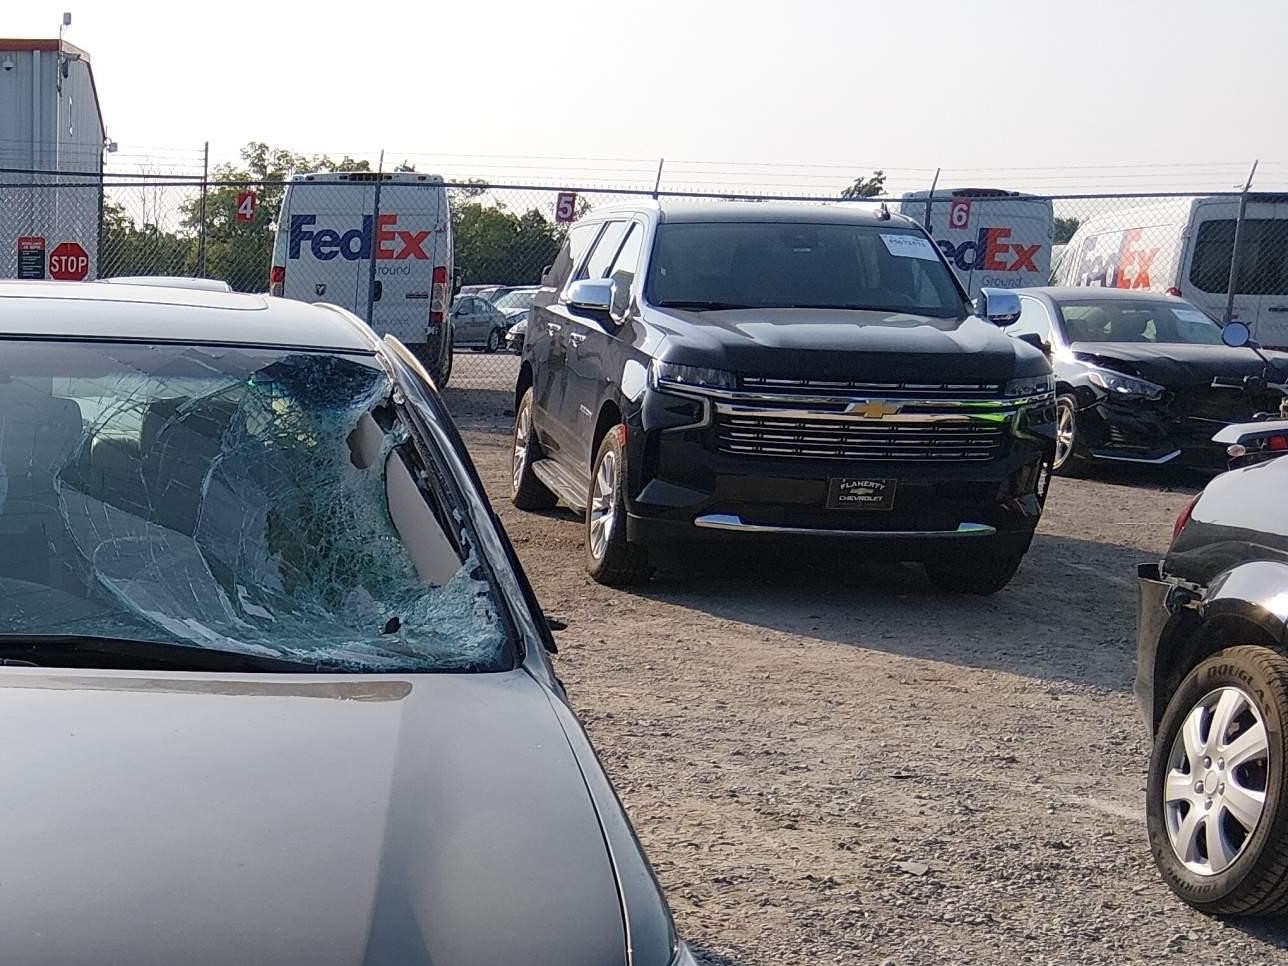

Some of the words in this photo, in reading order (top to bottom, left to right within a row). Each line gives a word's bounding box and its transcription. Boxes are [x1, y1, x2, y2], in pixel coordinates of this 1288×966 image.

[238, 195, 253, 218] 4
[557, 196, 573, 218] 5
[952, 203, 968, 226] 6
[288, 213, 433, 261] FedEx
[934, 227, 1042, 273] edEx
[50, 255, 87, 273] STOP
[376, 263, 411, 276] round
[981, 275, 1023, 288] Ground
[840, 480, 886, 490] FLAHERTY
